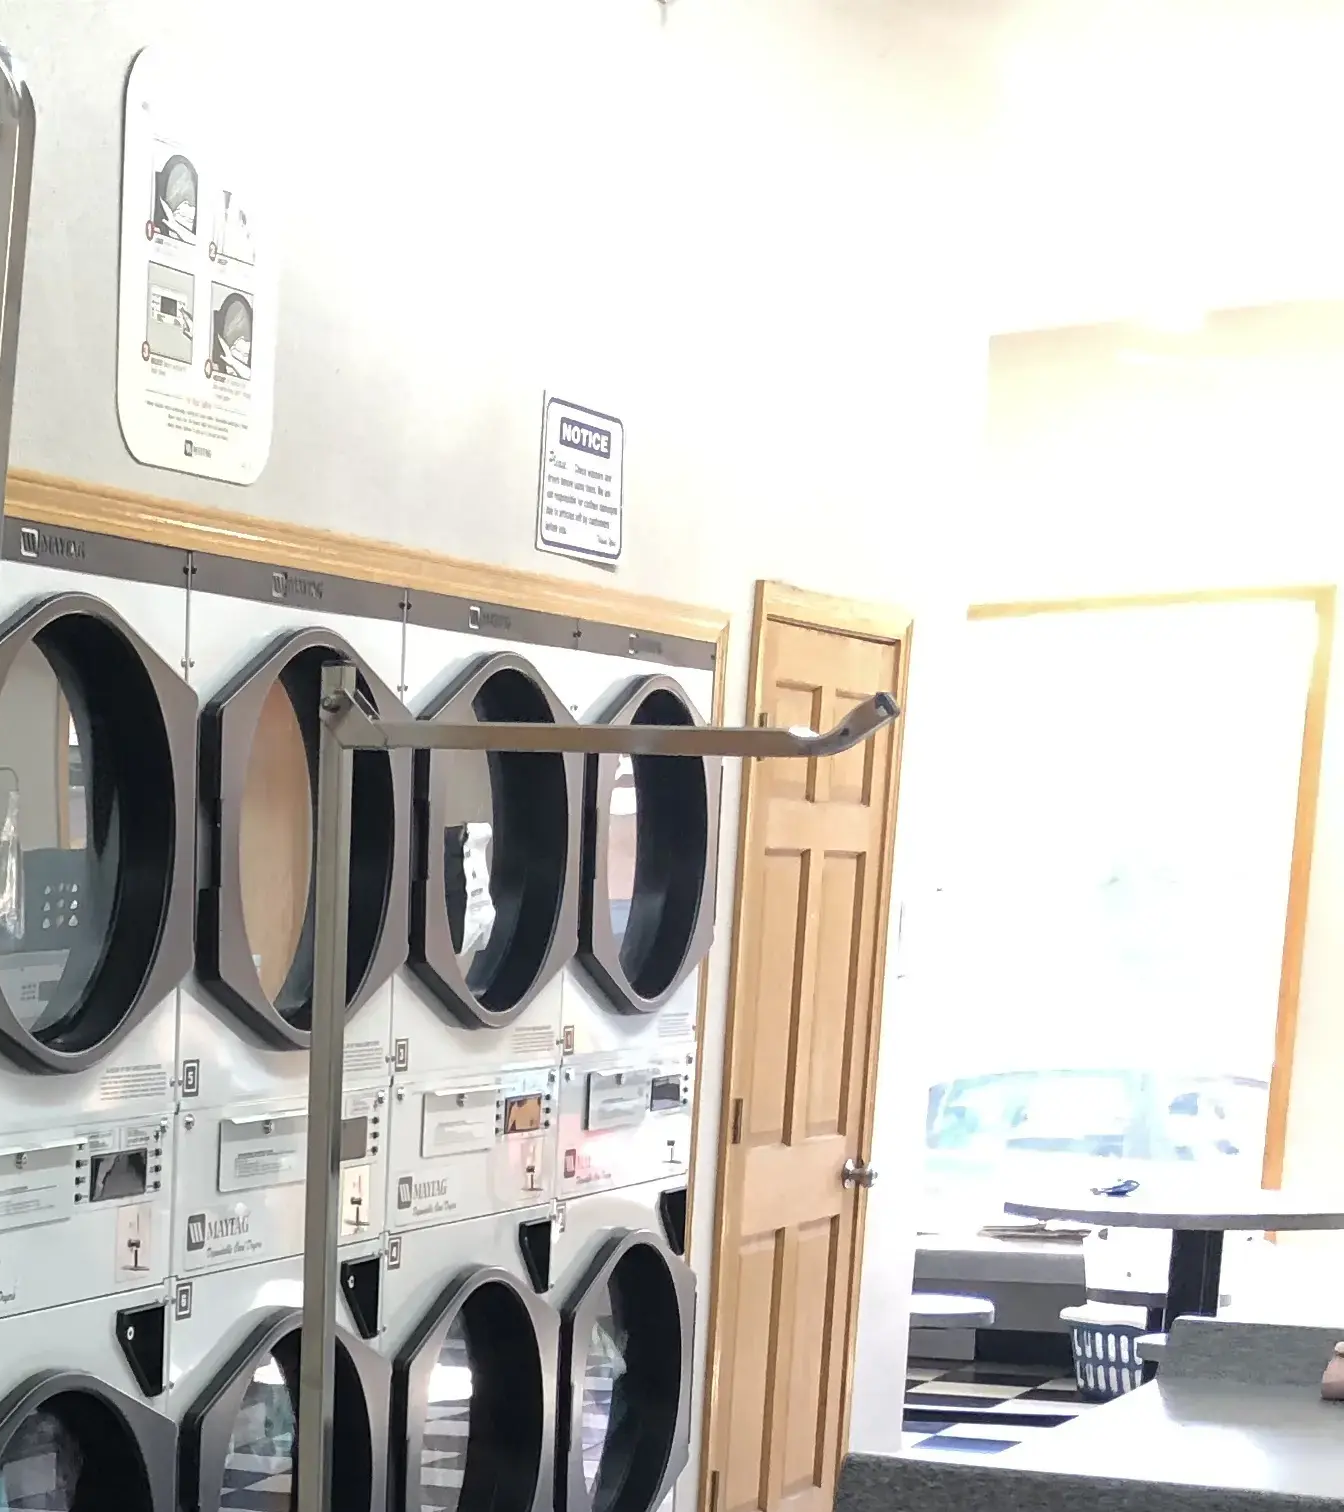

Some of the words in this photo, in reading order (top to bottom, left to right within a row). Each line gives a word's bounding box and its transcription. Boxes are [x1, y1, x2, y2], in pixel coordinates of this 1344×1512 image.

[562, 422, 609, 452] NOTICE
[188, 1071, 193, 1085] 5
[207, 1216, 249, 1240] MAYTAG
